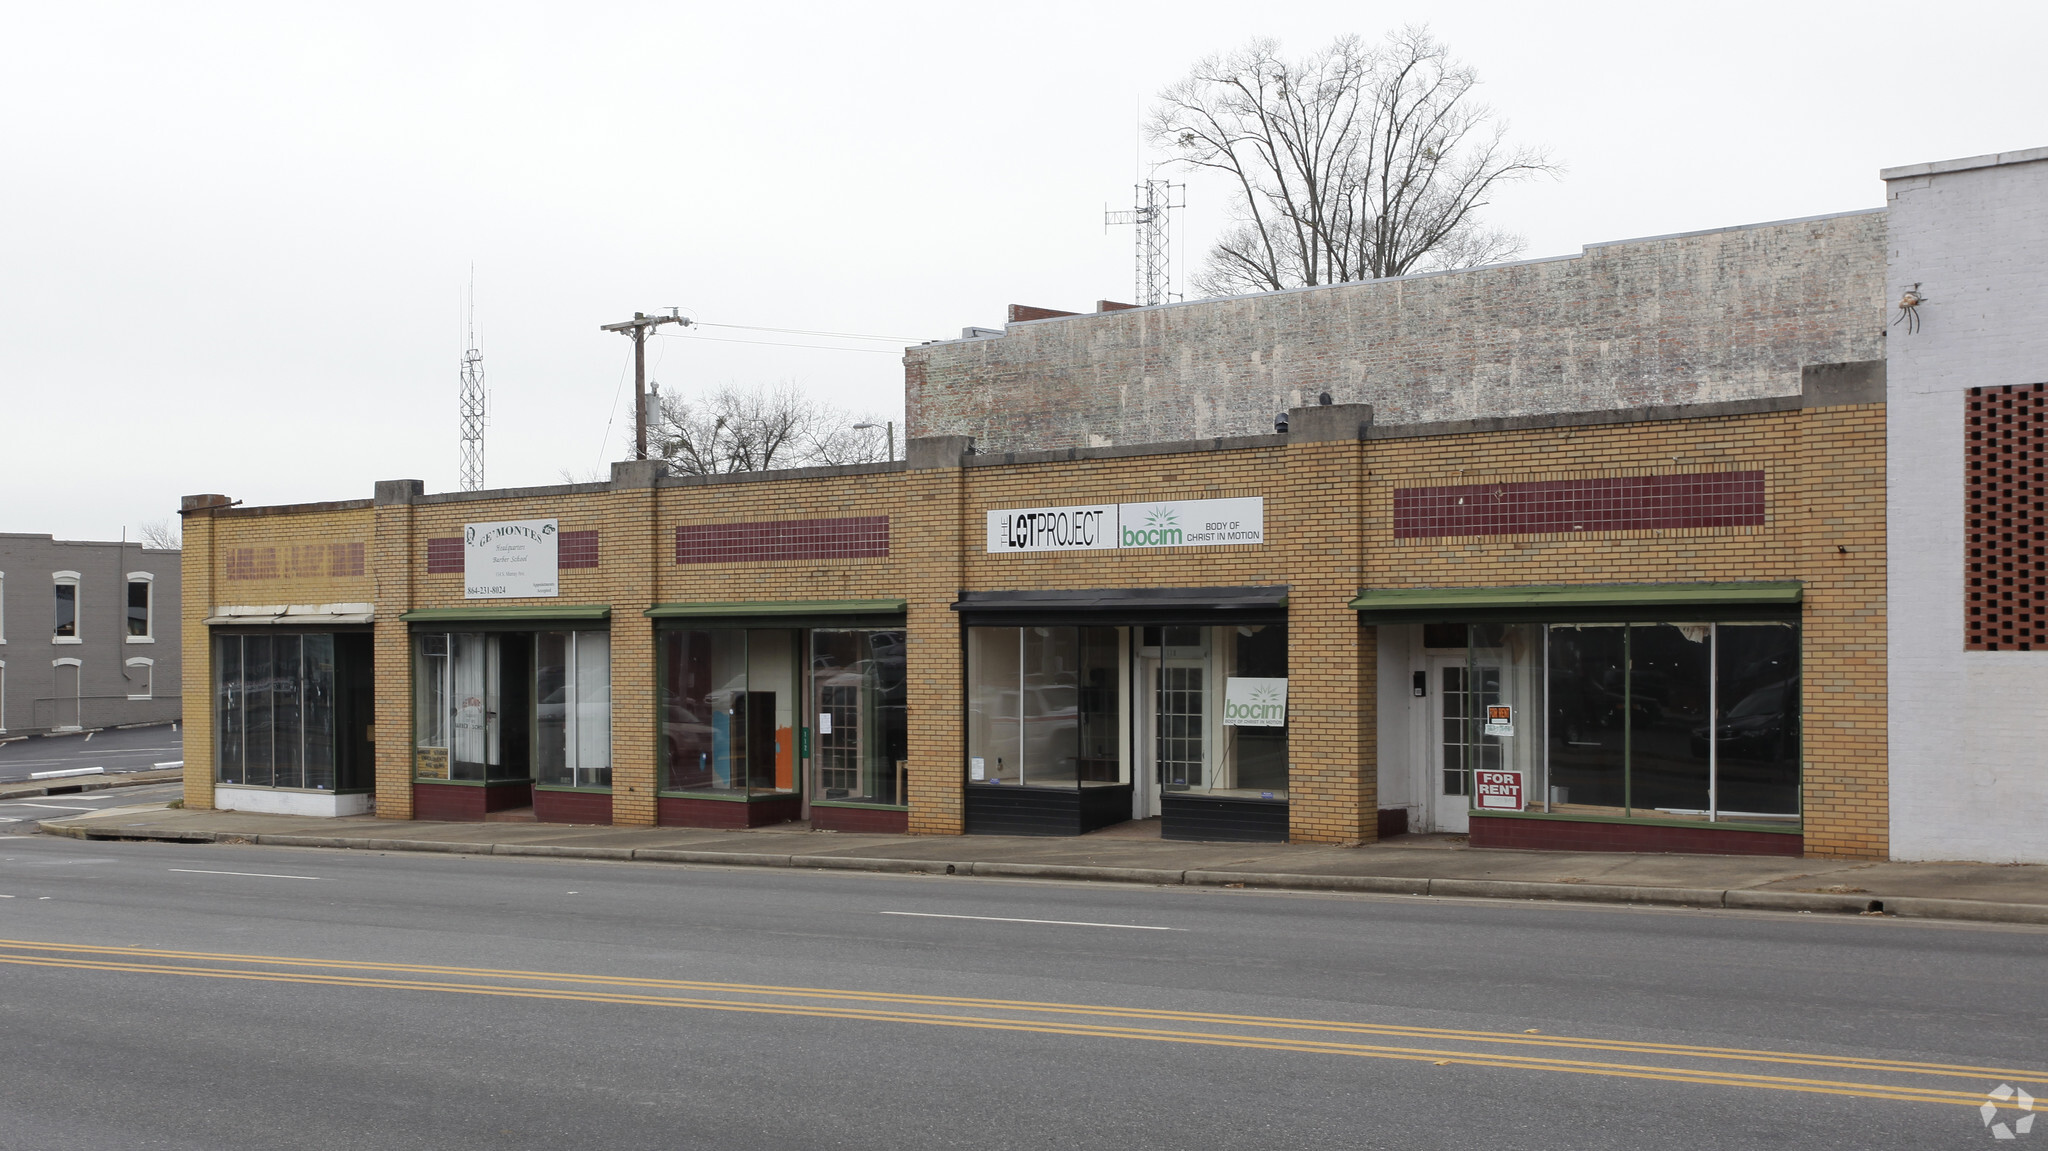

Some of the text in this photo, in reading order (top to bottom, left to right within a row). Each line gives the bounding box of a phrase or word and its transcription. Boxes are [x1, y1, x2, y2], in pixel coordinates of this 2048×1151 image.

[1205, 521, 1240, 531] BODY OF
[1122, 523, 1183, 546] bocim
[1186, 530, 1260, 542] CHRIST IN MOTION
[467, 585, 506, 595] 864-231-8024
[1225, 698, 1284, 719] bocim
[1483, 773, 1514, 784] FOR
[1479, 784, 1519, 795] RENT
